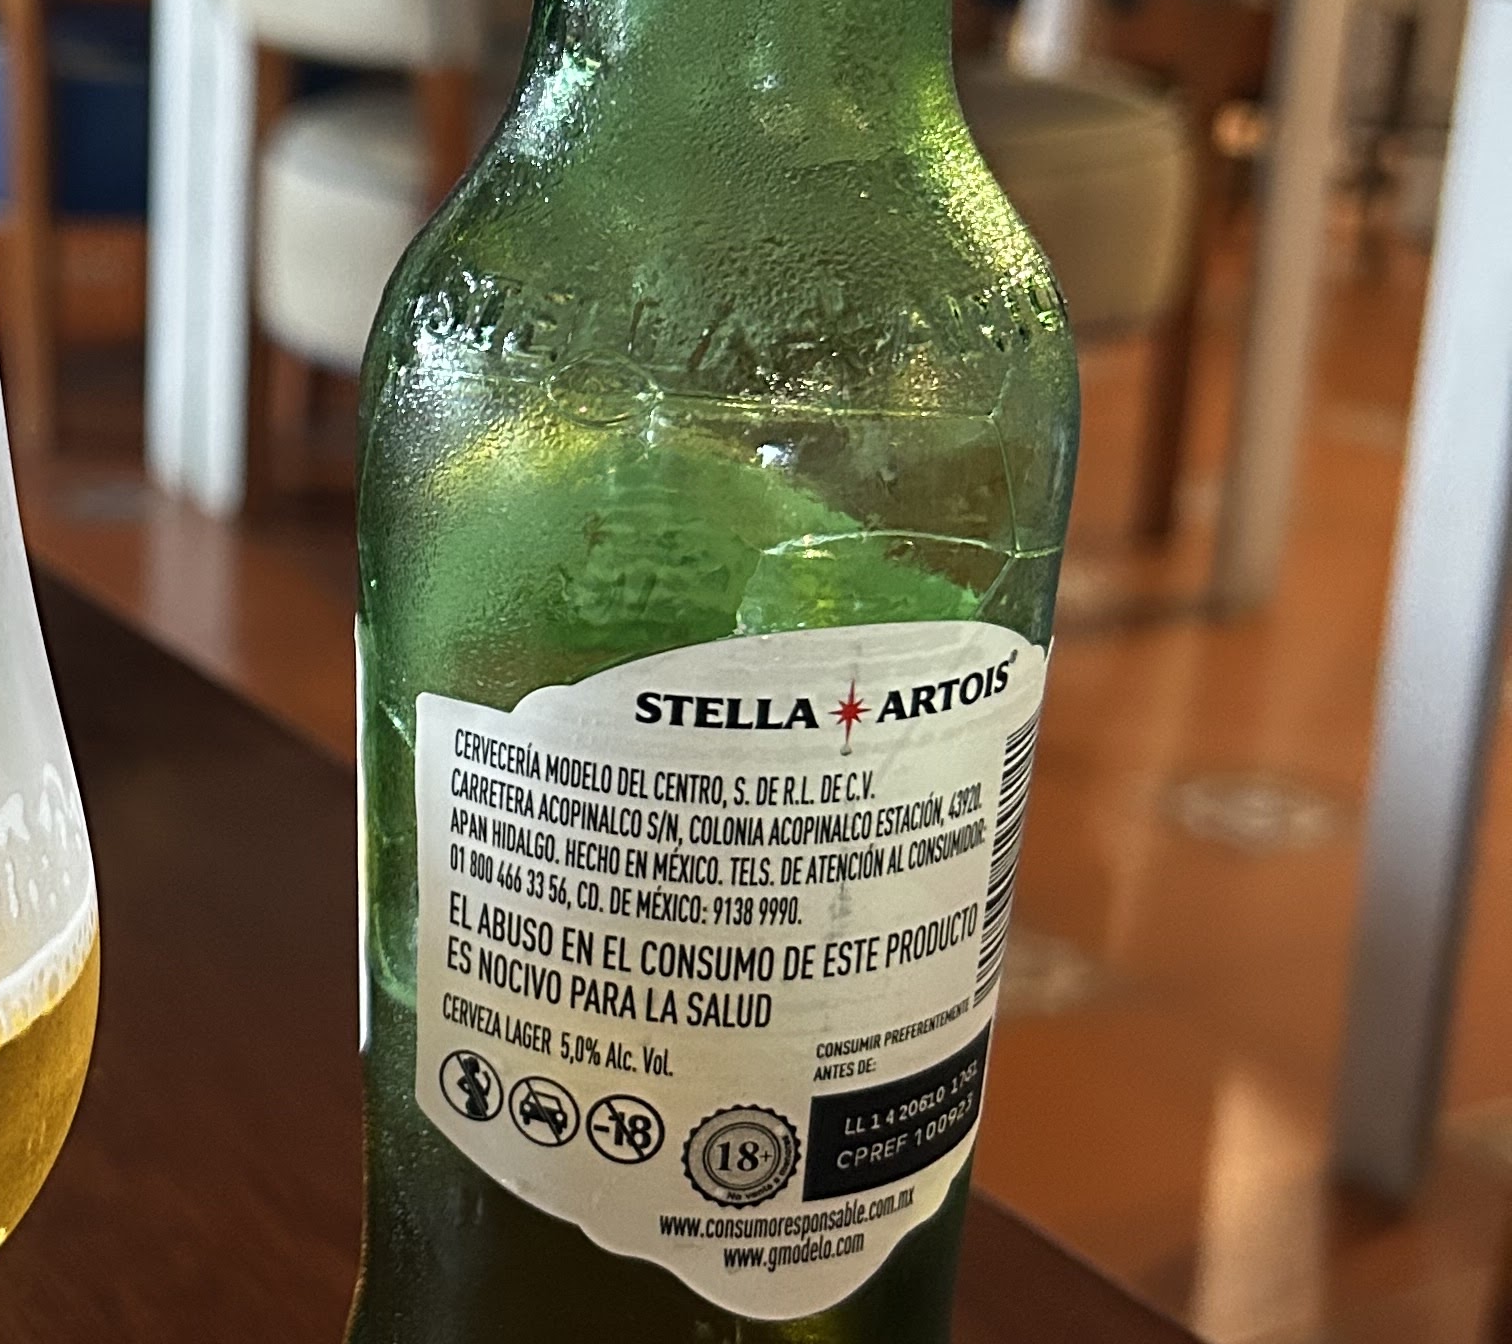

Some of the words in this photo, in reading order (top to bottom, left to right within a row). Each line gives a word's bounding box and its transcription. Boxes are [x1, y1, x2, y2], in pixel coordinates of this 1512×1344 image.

[635, 691, 820, 730] STELLA
[875, 660, 1011, 724] ARTOIS
[451, 768, 534, 819] CARRETERA
[538, 793, 642, 838] ACOPINALCO
[647, 810, 683, 846] S/N,
[689, 814, 764, 846] COLONIA
[768, 810, 873, 847] ACOPINALCO
[875, 791, 944, 838] ESTACIÓN,
[455, 728, 541, 780] CERVECERÍA
[545, 753, 613, 794] MODELO
[618, 766, 648, 799] DEL
[653, 771, 728, 808] CENTRO,
[733, 776, 750, 806] S.
[756, 775, 778, 806] DE
[783, 775, 815, 805] R.L.
[820, 773, 843, 804] DE
[846, 770, 876, 802] C.V.
[450, 807, 488, 844] APAN
[491, 819, 560, 865] HIDALGO.
[565, 838, 620, 875] HECHO
[625, 848, 647, 879] EN
[652, 846, 723, 886] MÉXICO.
[730, 856, 775, 886] TELS.
[781, 856, 801, 886] DE
[805, 843, 883, 885] ATENCIÓN
[887, 844, 904, 875] AL
[908, 817, 987, 870] CONSUMIDOR:
[450, 843, 465, 874] 01
[470, 850, 494, 884] 800
[497, 858, 522, 893] 466
[526, 868, 545, 899] 33
[548, 873, 572, 910] 56,
[577, 881, 604, 913] CD.
[610, 886, 632, 917] DE
[636, 885, 708, 925] MÉXICO:
[713, 896, 753, 926] 9138
[758, 895, 803, 926] 9990.
[449, 890, 473, 931] EL
[477, 903, 553, 957] ABUSO
[561, 926, 594, 967] EN
[603, 934, 632, 972] EL
[640, 940, 775, 982] CONSUMO
[783, 944, 816, 981] DE
[823, 936, 881, 978] ESTE
[885, 902, 979, 969] PRODUCTO
[447, 934, 472, 975] ES
[478, 947, 562, 1005] NOCIVO
[570, 974, 637, 1020] PARA
[646, 987, 678, 1025] LA
[687, 991, 773, 1028] SALUD
[443, 992, 502, 1040] CERVEZA
[505, 1015, 552, 1055] LAGER
[560, 1031, 601, 1066] 5,0%
[605, 1042, 637, 1073] Alc.
[643, 1046, 674, 1077] Vol.
[816, 1033, 881, 1059] CONSUMIR
[883, 997, 970, 1048] PREFERENTEMENTE
[813, 1061, 854, 1082] ANTES
[857, 1057, 877, 1076] DE:
[837, 1133, 909, 1169] CPREF
[659, 1186, 915, 1240] www.consumoresponsable.com.mx
[723, 1233, 864, 1272] www.gmodelo.com
